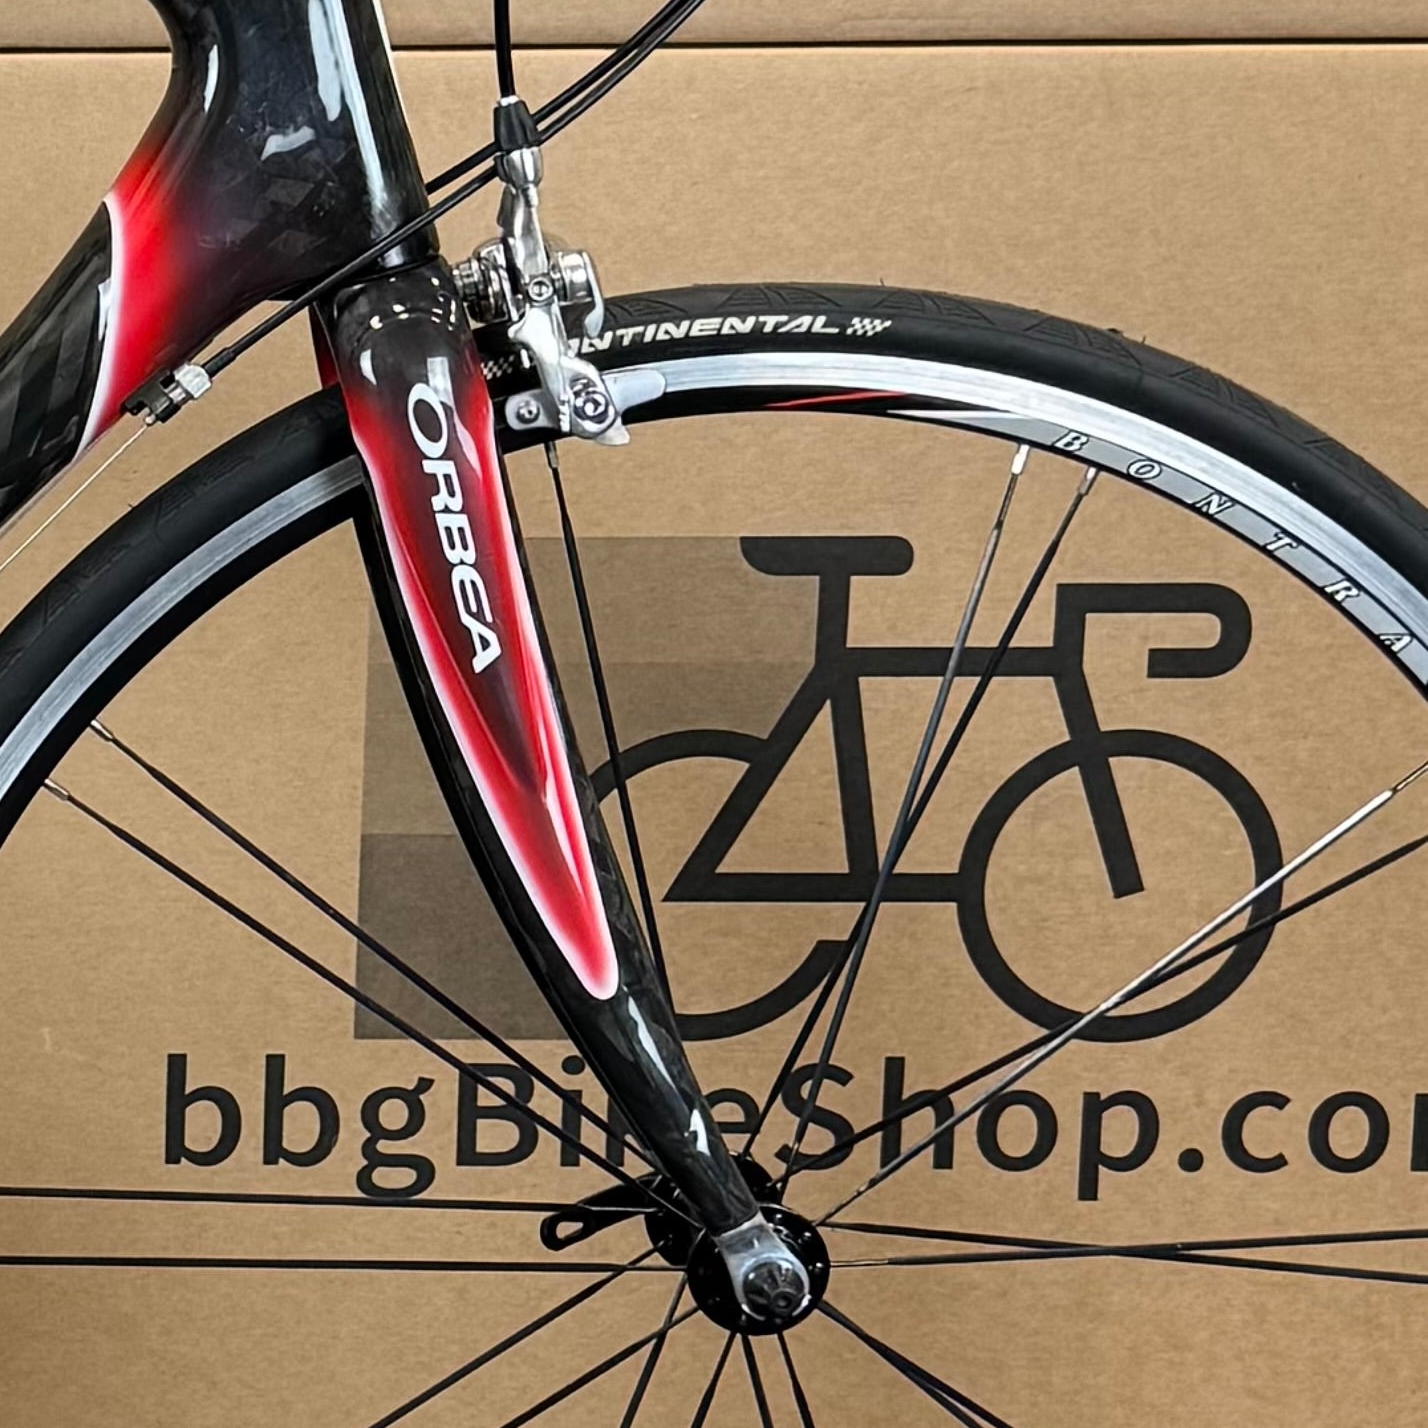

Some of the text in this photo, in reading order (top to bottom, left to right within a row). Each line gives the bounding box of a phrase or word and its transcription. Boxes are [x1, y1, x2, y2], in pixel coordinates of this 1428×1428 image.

[567, 314, 841, 356] NTINENTAL
[406, 383, 500, 675] ORBEA
[162, 1053, 1428, 1202] bbgBieShop.co
